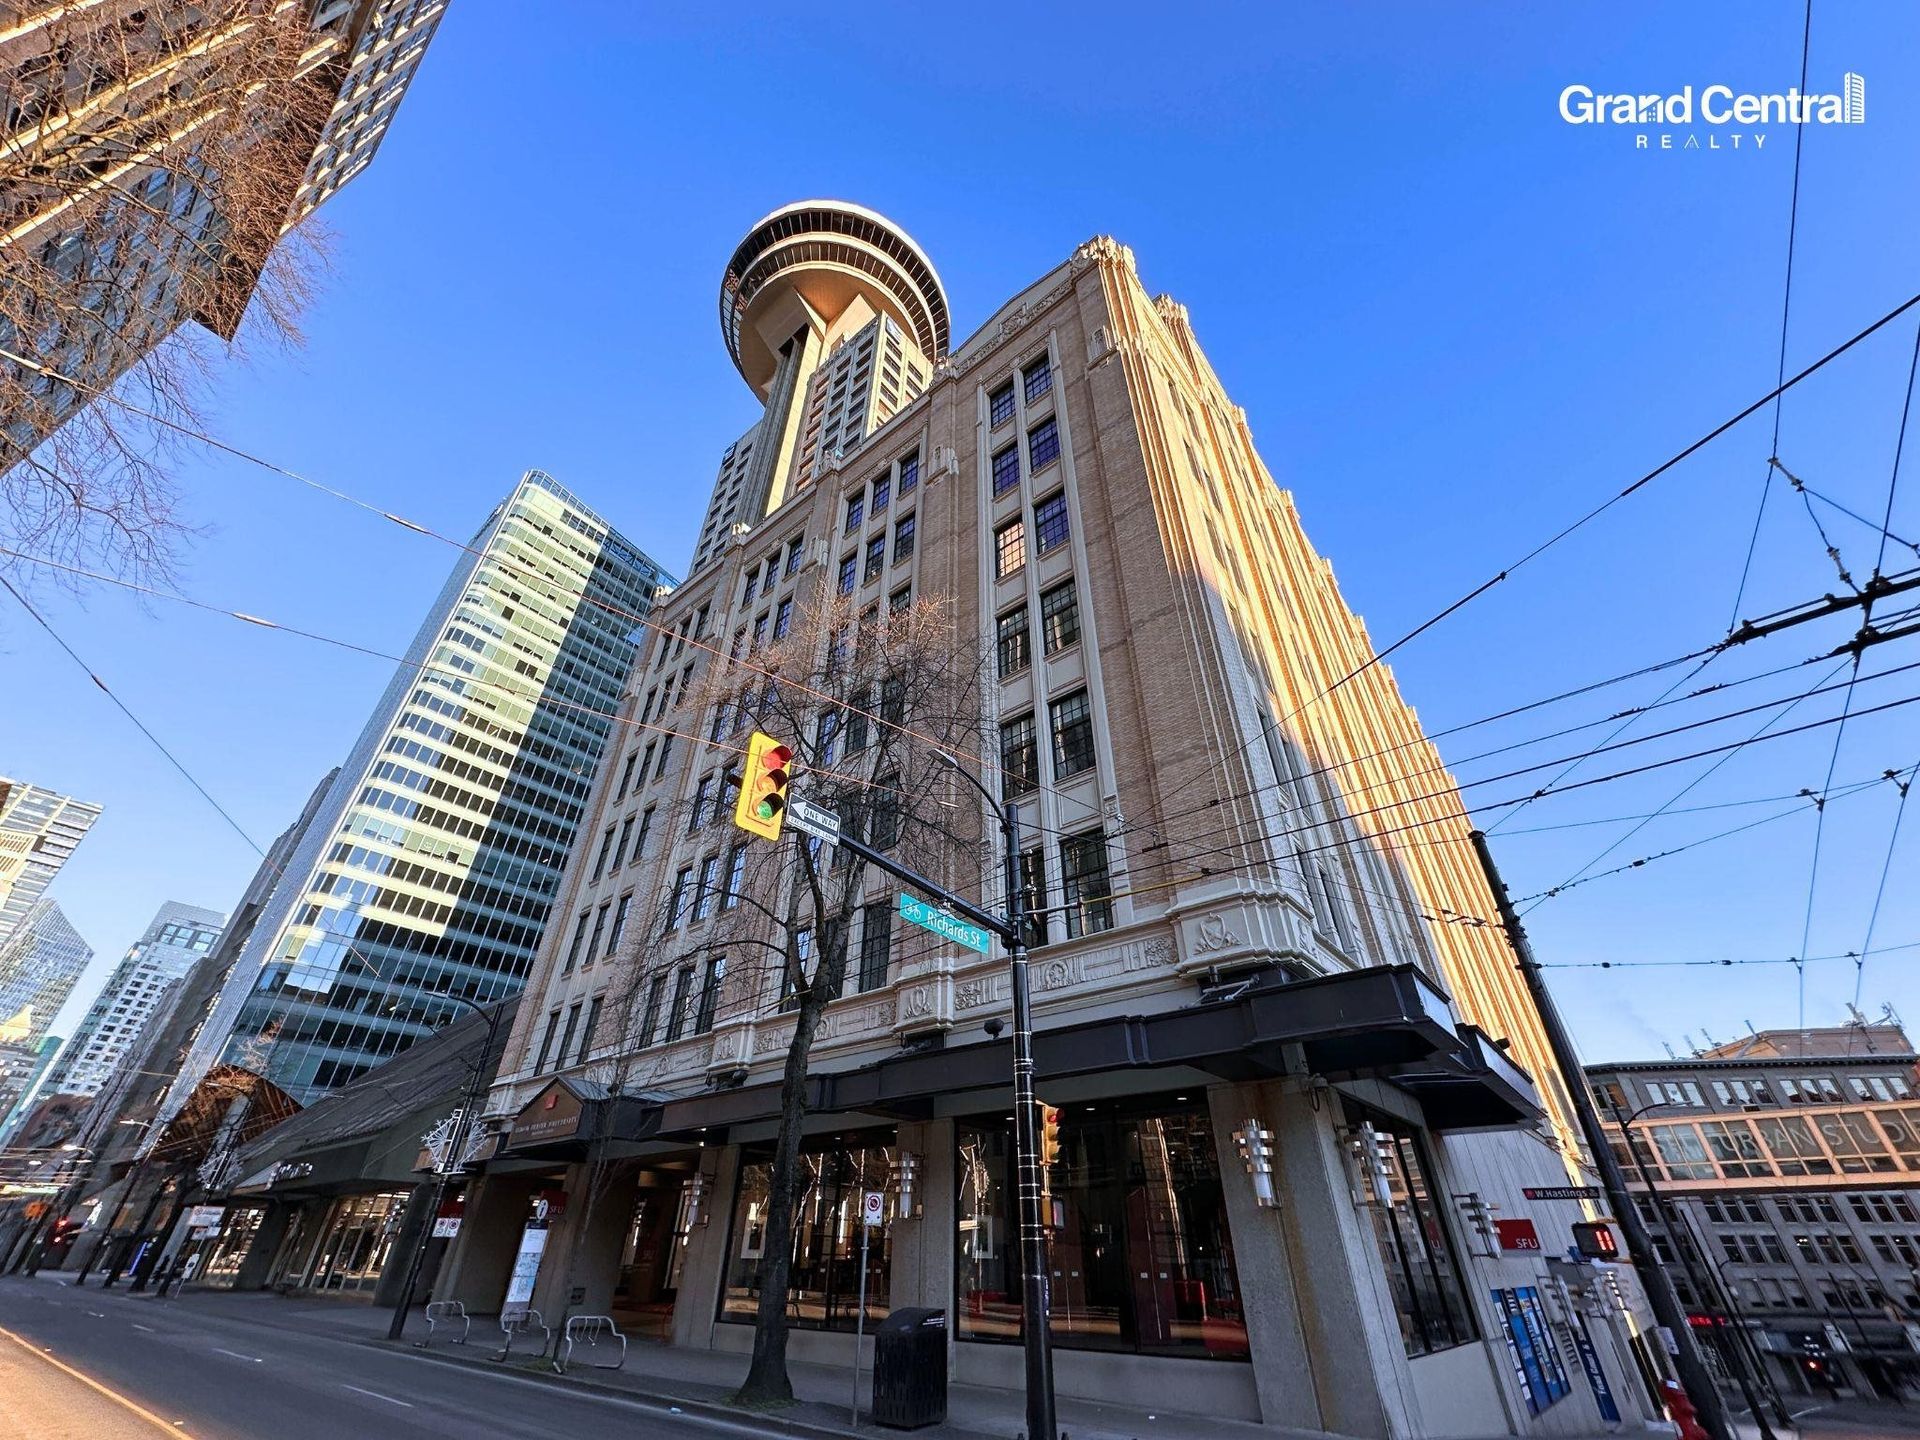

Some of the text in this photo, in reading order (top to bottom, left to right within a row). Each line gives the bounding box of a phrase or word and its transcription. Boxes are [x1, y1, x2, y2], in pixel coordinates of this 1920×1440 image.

[803, 807, 837, 829] ONE WAY
[927, 910, 982, 947] Richards St
[1717, 1125, 1817, 1151] URBAN
[1516, 1238, 1539, 1249] SFU
[1595, 1230, 1615, 1251] 11
